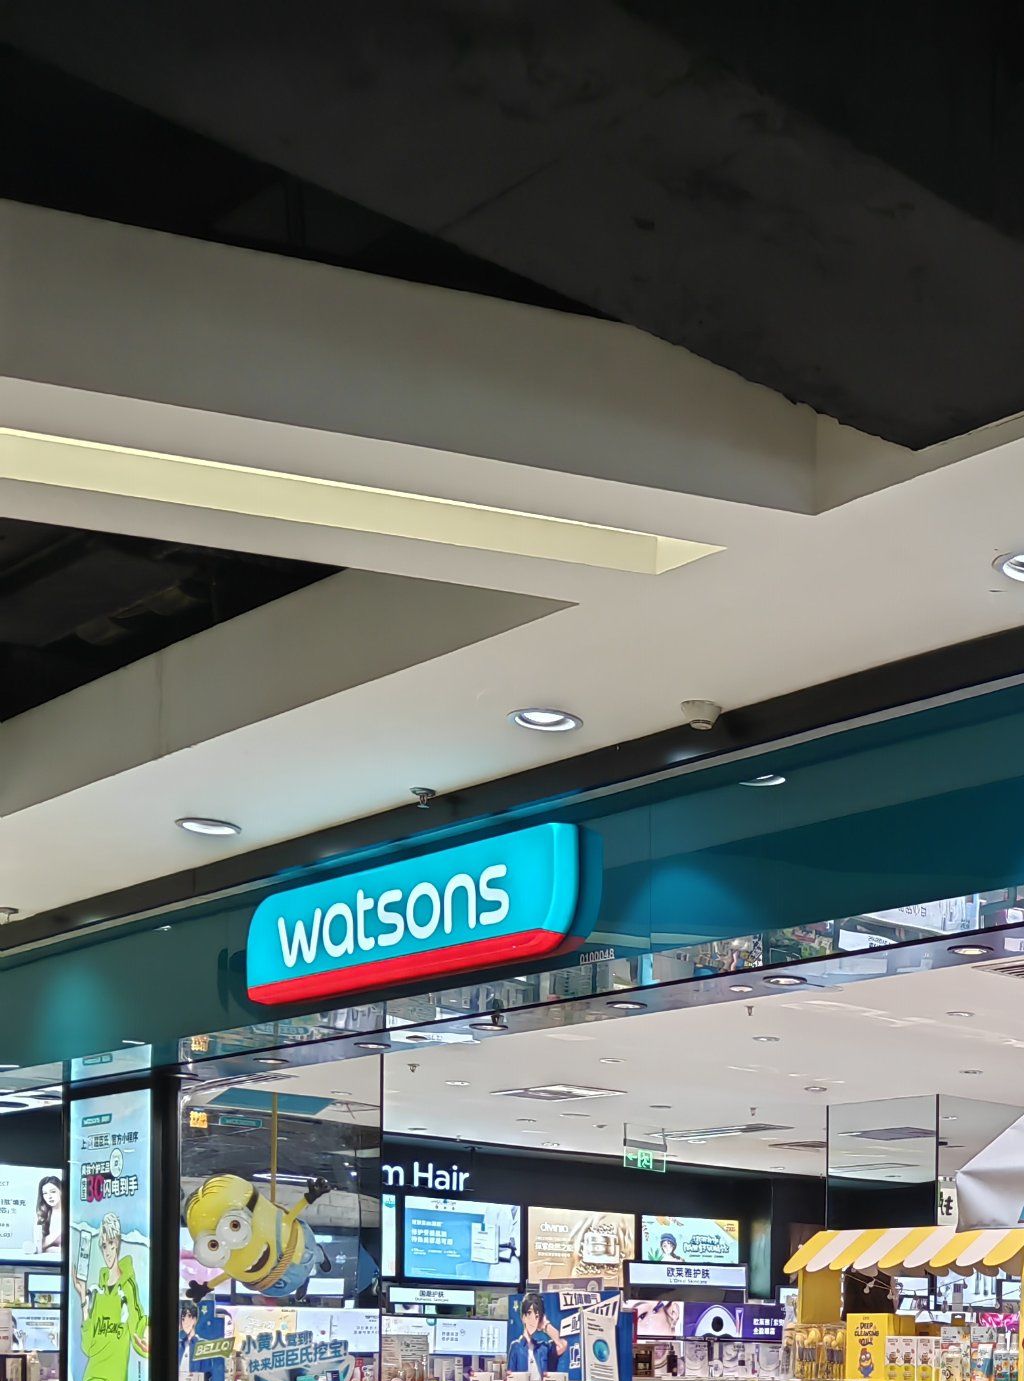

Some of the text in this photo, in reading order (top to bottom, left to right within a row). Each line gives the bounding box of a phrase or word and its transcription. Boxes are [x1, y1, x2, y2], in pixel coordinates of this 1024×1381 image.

[278, 864, 510, 968] watsons
[413, 1161, 470, 1192] Hair
[666, 1266, 711, 1279] 欧莱雅护肤
[196, 1340, 233, 1356] BELLO!
